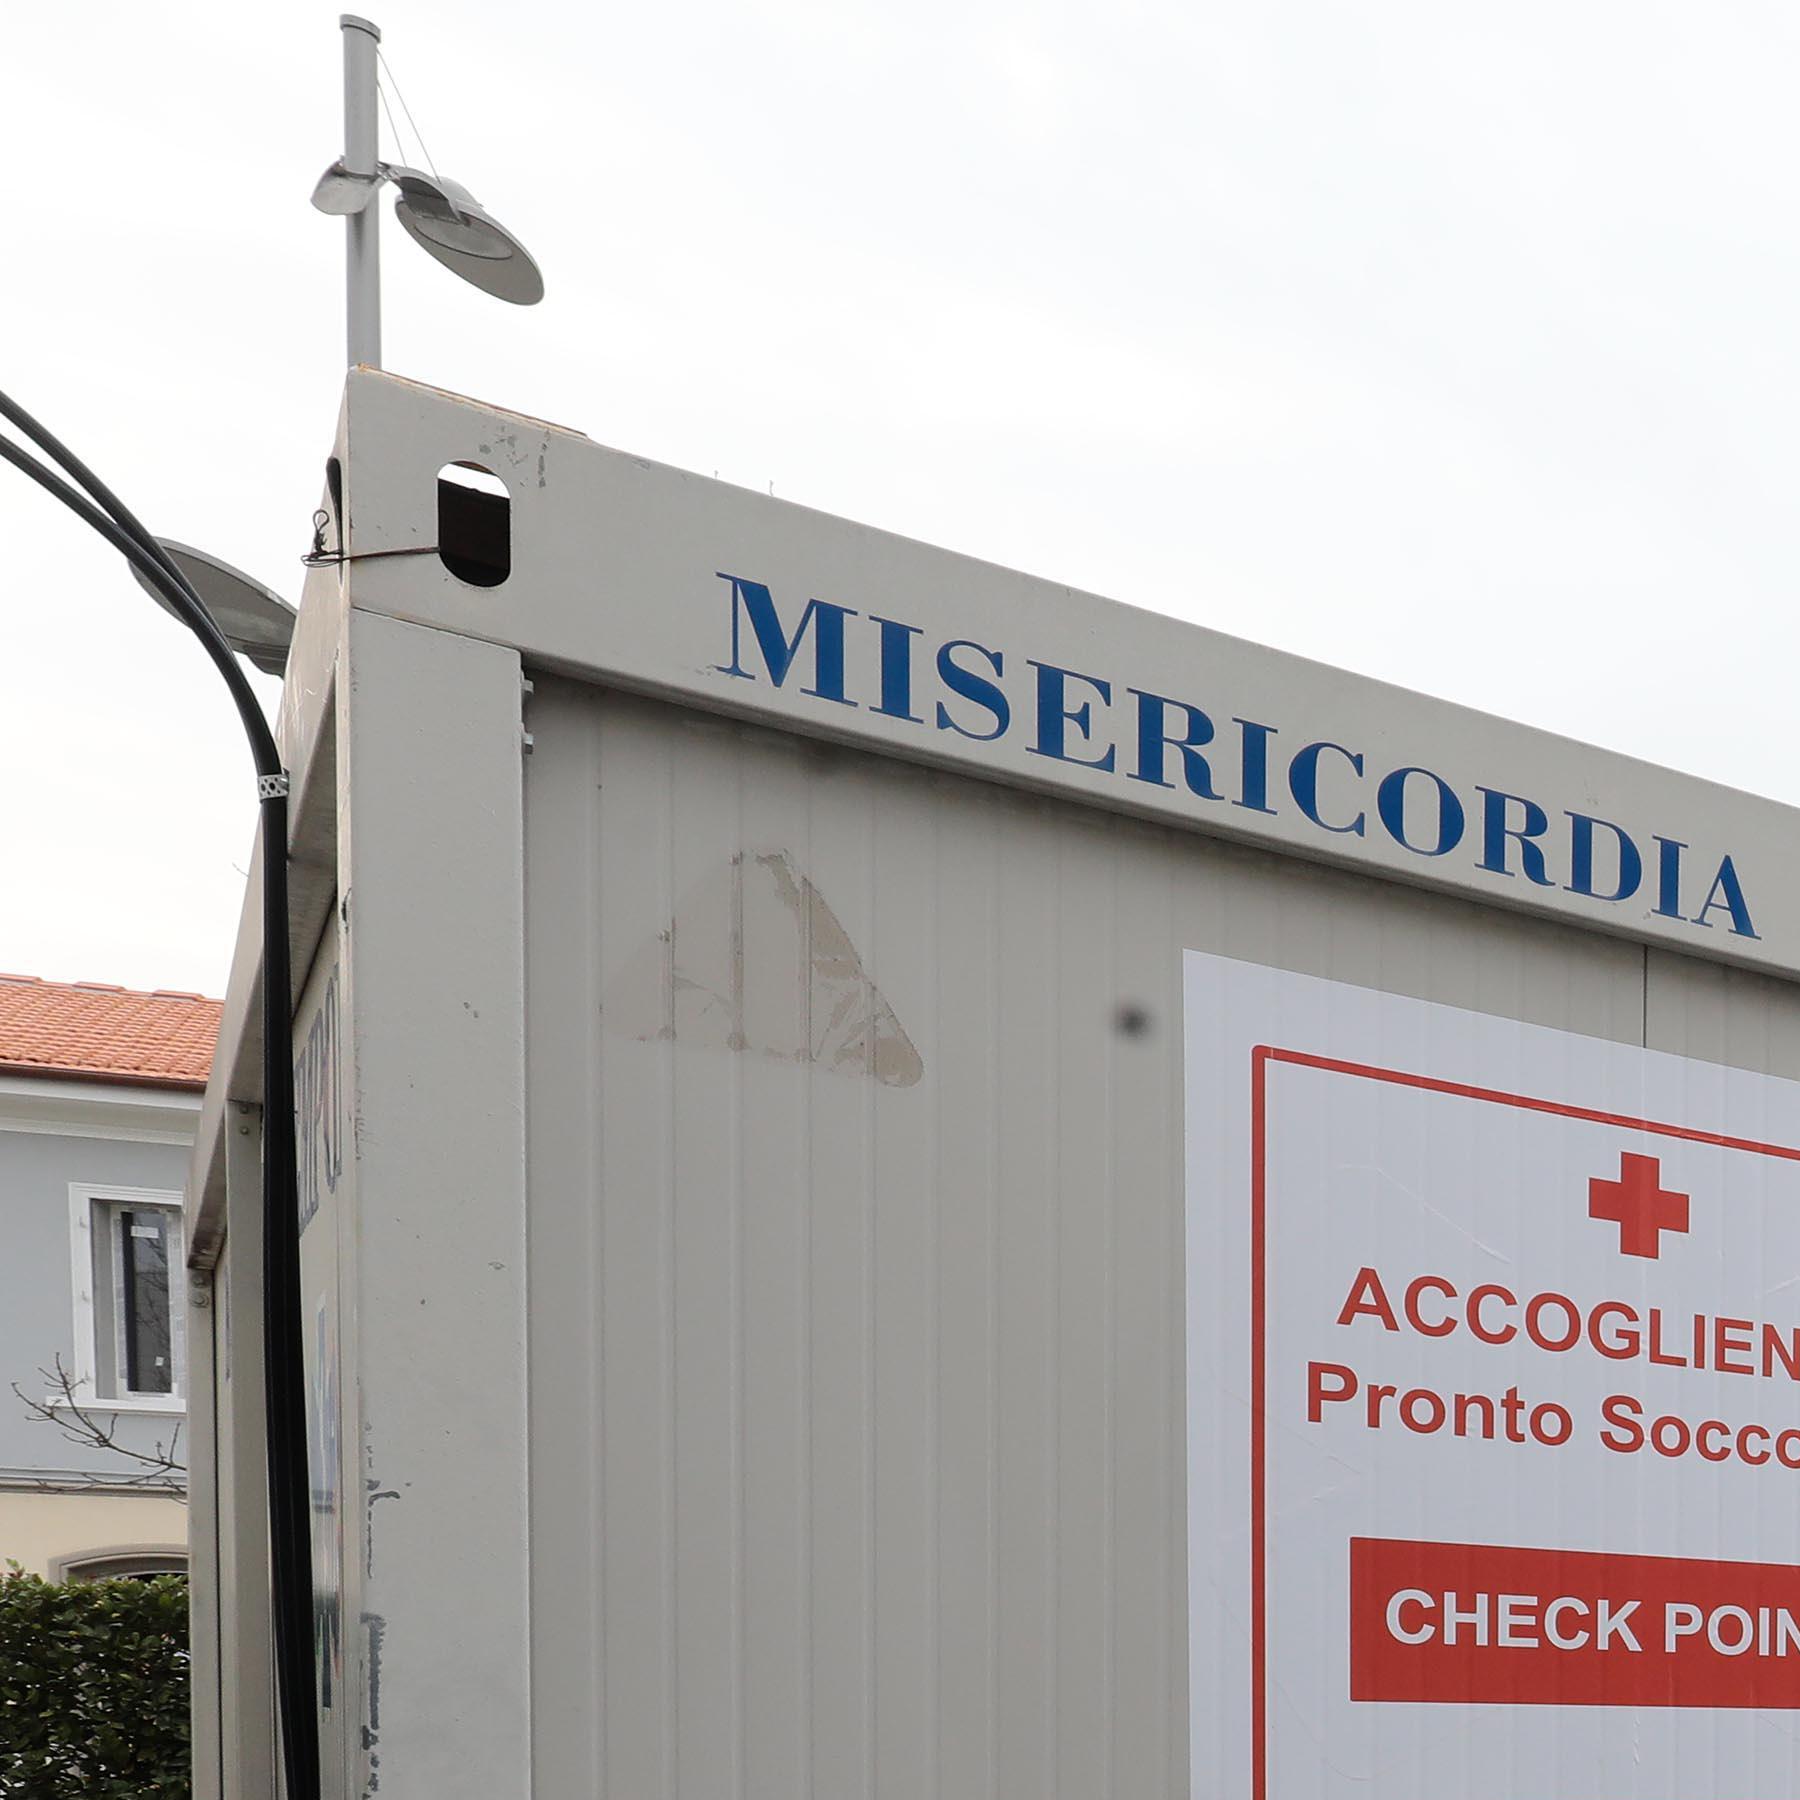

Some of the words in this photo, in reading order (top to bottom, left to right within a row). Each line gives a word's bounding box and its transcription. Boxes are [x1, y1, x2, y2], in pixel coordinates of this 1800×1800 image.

[715, 571, 1761, 939] MISERICORDIA
[1307, 1361, 1573, 1446] Pronto
[1385, 1587, 1643, 1653] CHECK
